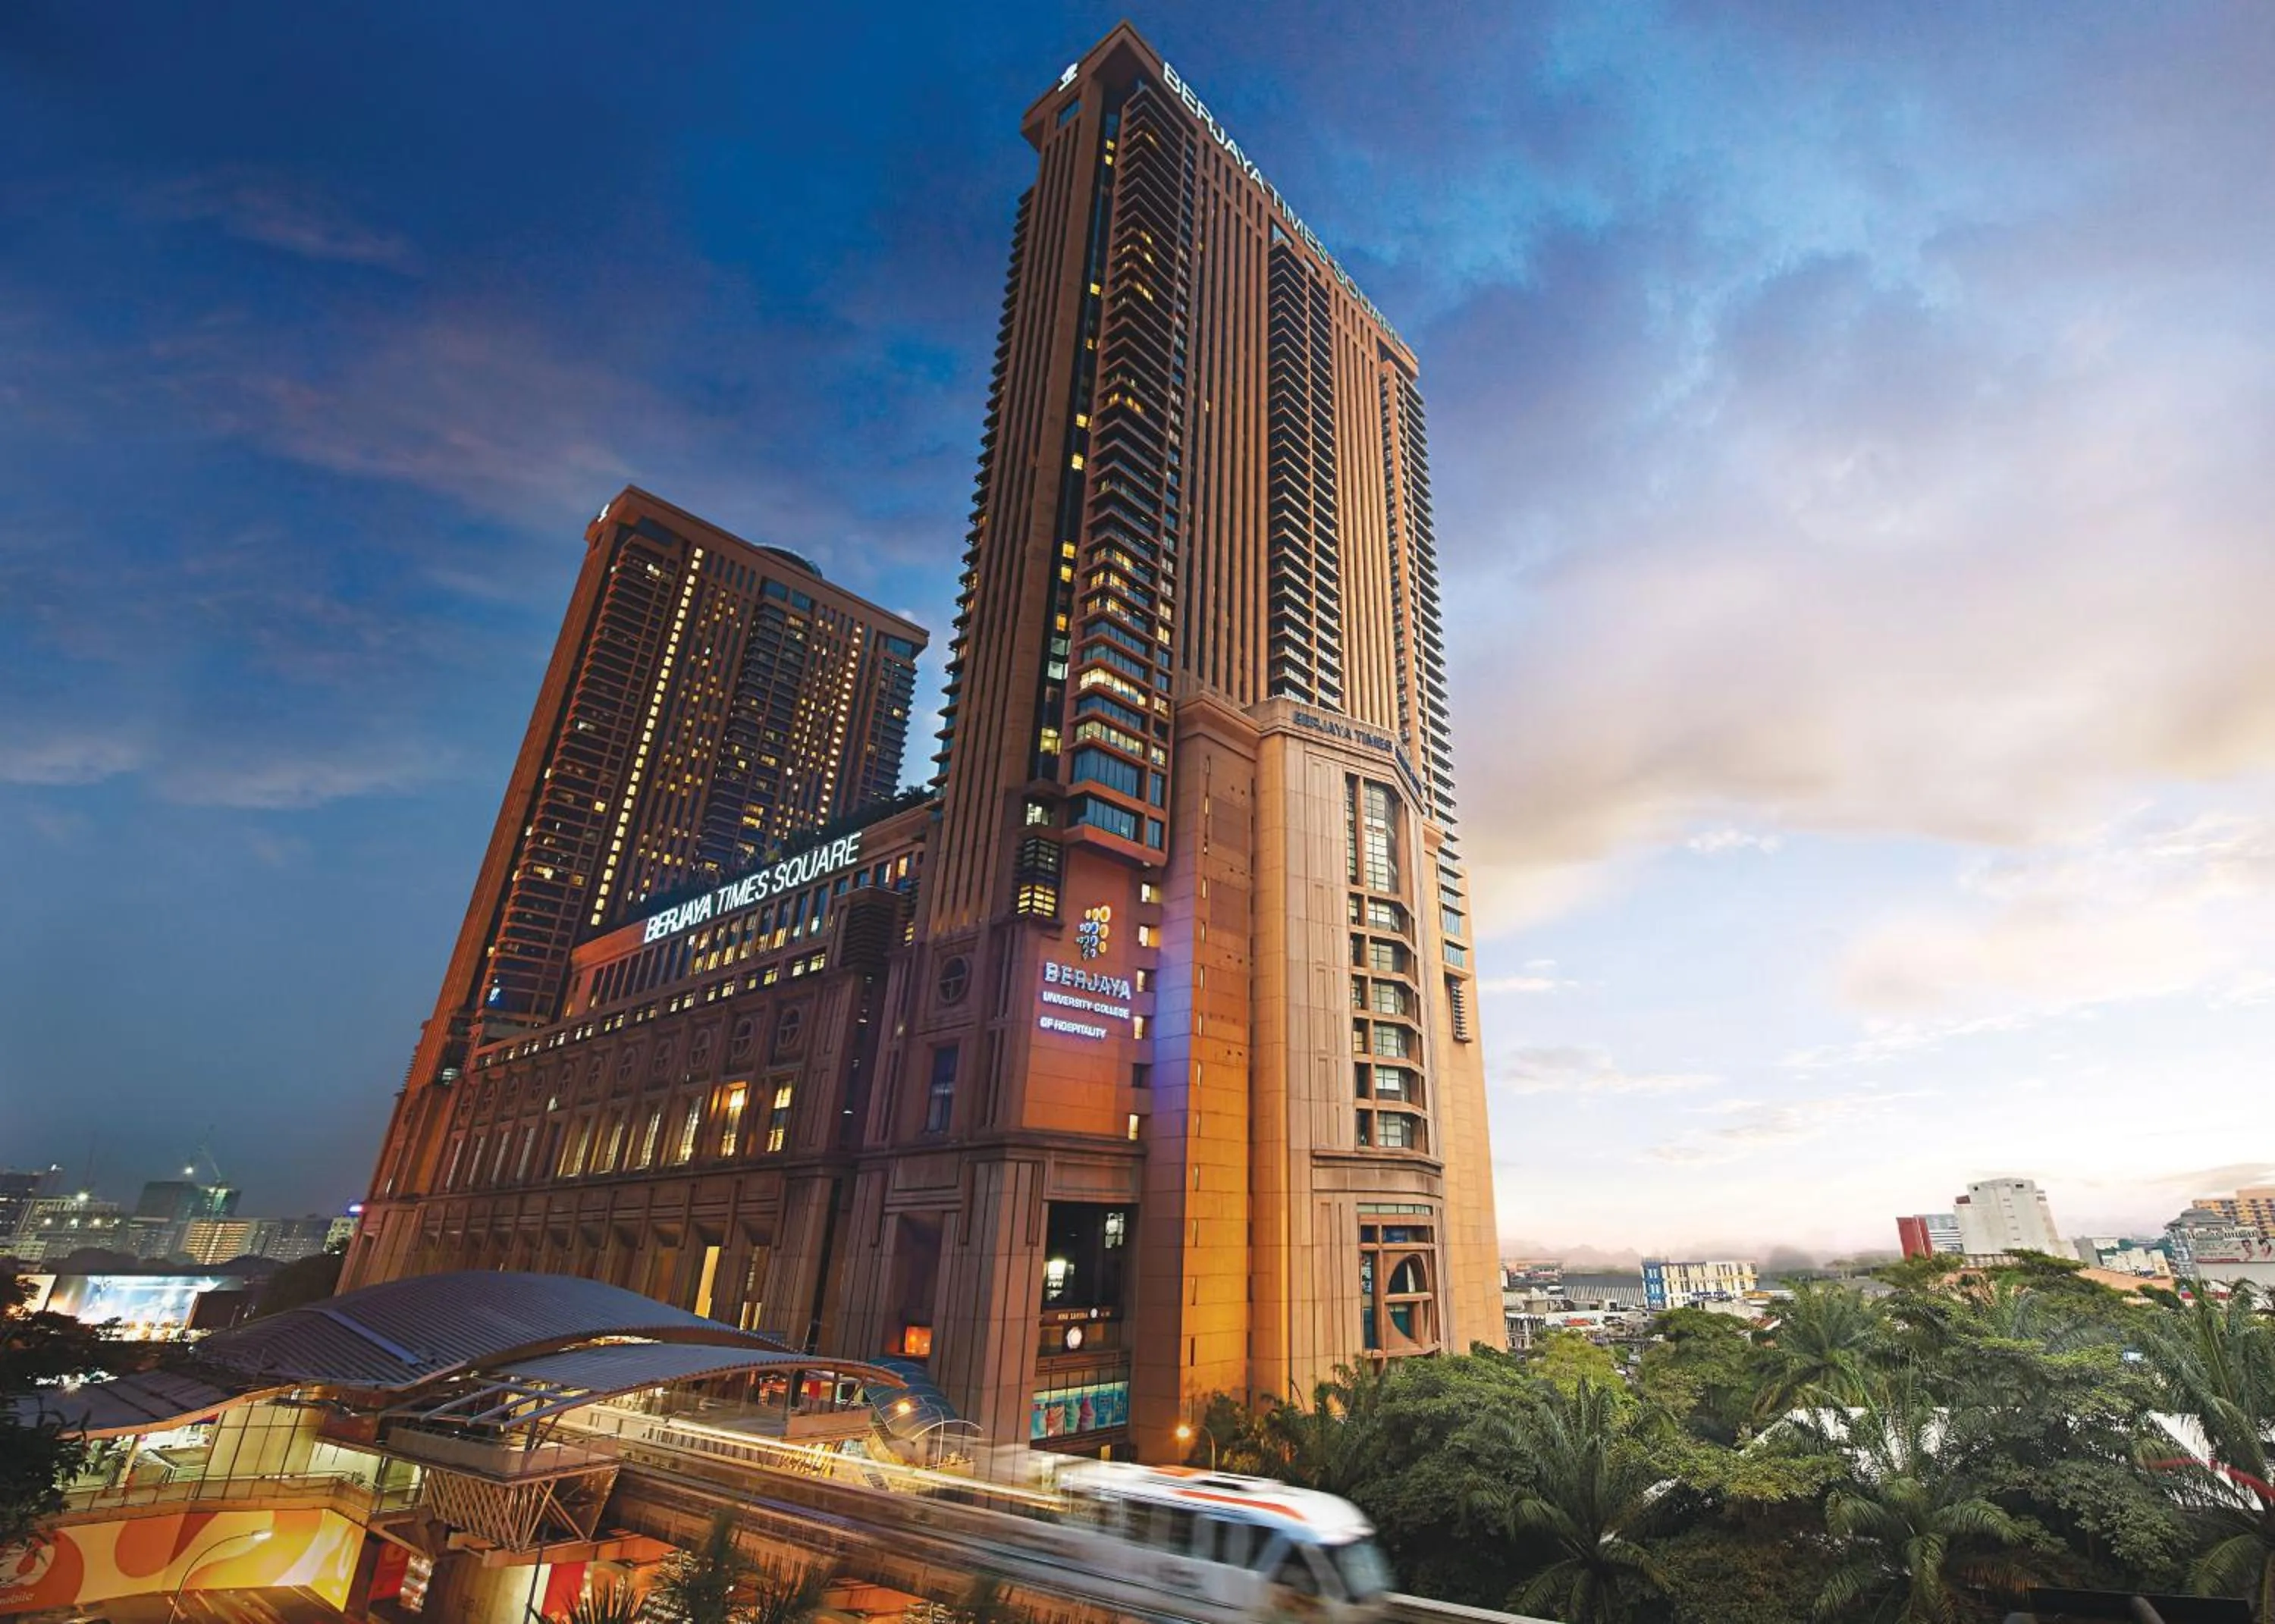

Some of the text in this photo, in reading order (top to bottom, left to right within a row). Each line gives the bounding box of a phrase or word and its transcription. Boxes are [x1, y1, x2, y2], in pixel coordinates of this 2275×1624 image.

[1163, 61, 1266, 195] BERJAYA
[1268, 183, 1329, 265] TIMES
[644, 832, 863, 944] BERJAYA TIMES SQUARE
[1044, 962, 1131, 1000] BERJAYA
[1040, 1016, 1107, 1039] OF HOSPITALITY
